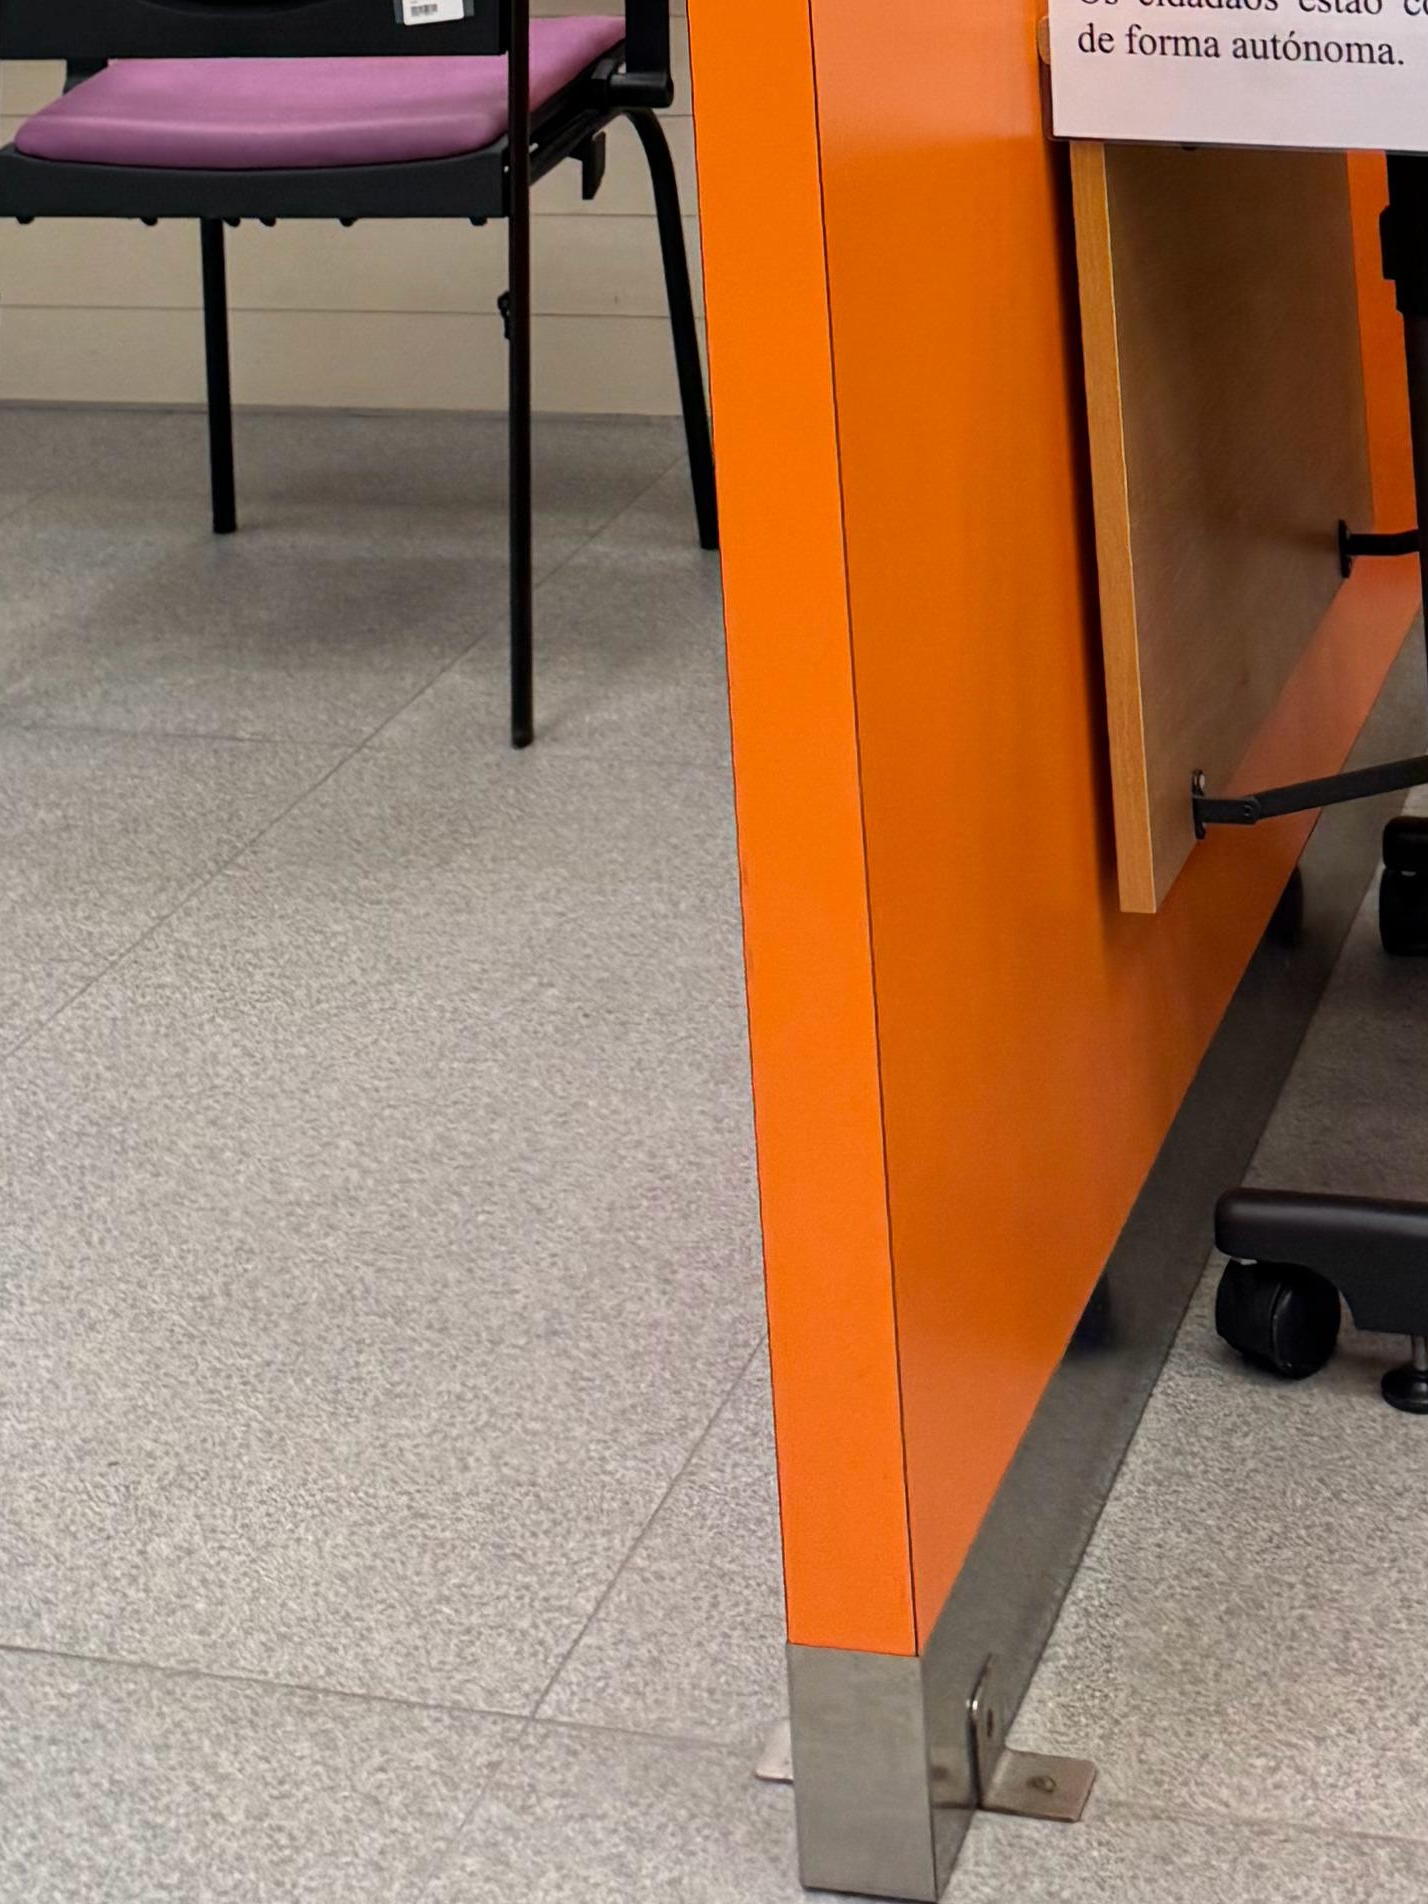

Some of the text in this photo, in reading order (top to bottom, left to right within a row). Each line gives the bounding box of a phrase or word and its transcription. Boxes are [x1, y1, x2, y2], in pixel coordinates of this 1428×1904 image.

[1078, 22, 1404, 65] de forma autónoma.
